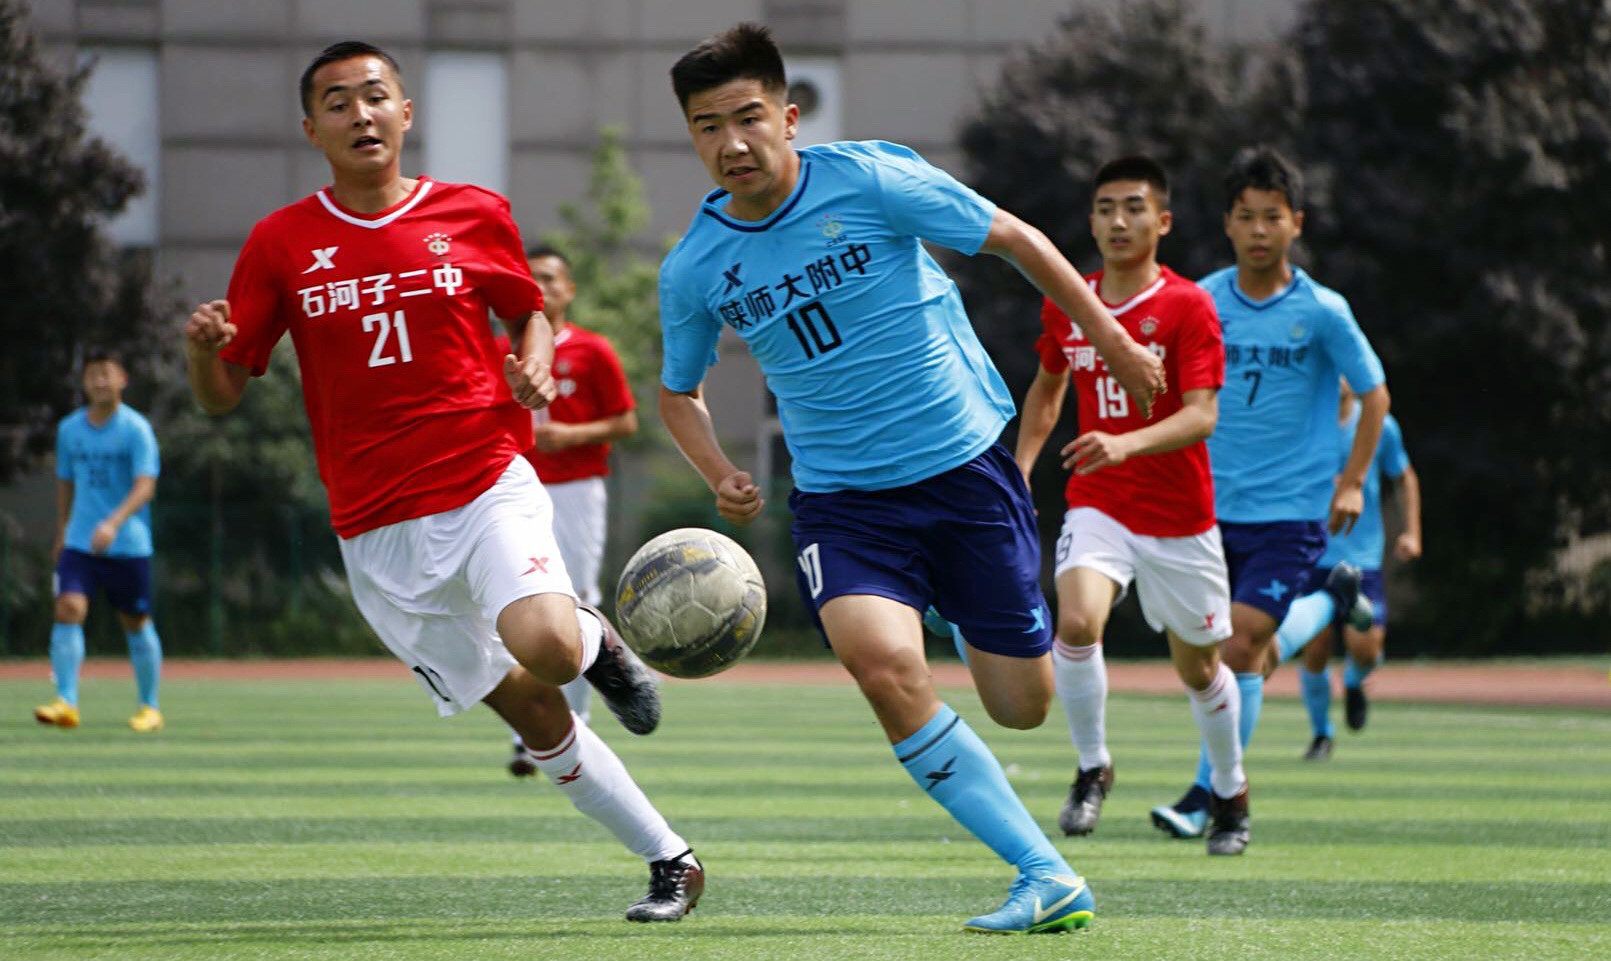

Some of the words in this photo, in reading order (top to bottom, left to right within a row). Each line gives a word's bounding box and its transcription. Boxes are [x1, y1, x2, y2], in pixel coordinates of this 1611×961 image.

[297, 263, 462, 318] 石河子二中
[362, 310, 412, 368] 21
[785, 301, 842, 360] 10
[1095, 376, 1129, 419] 19
[1242, 370, 1261, 406] 7
